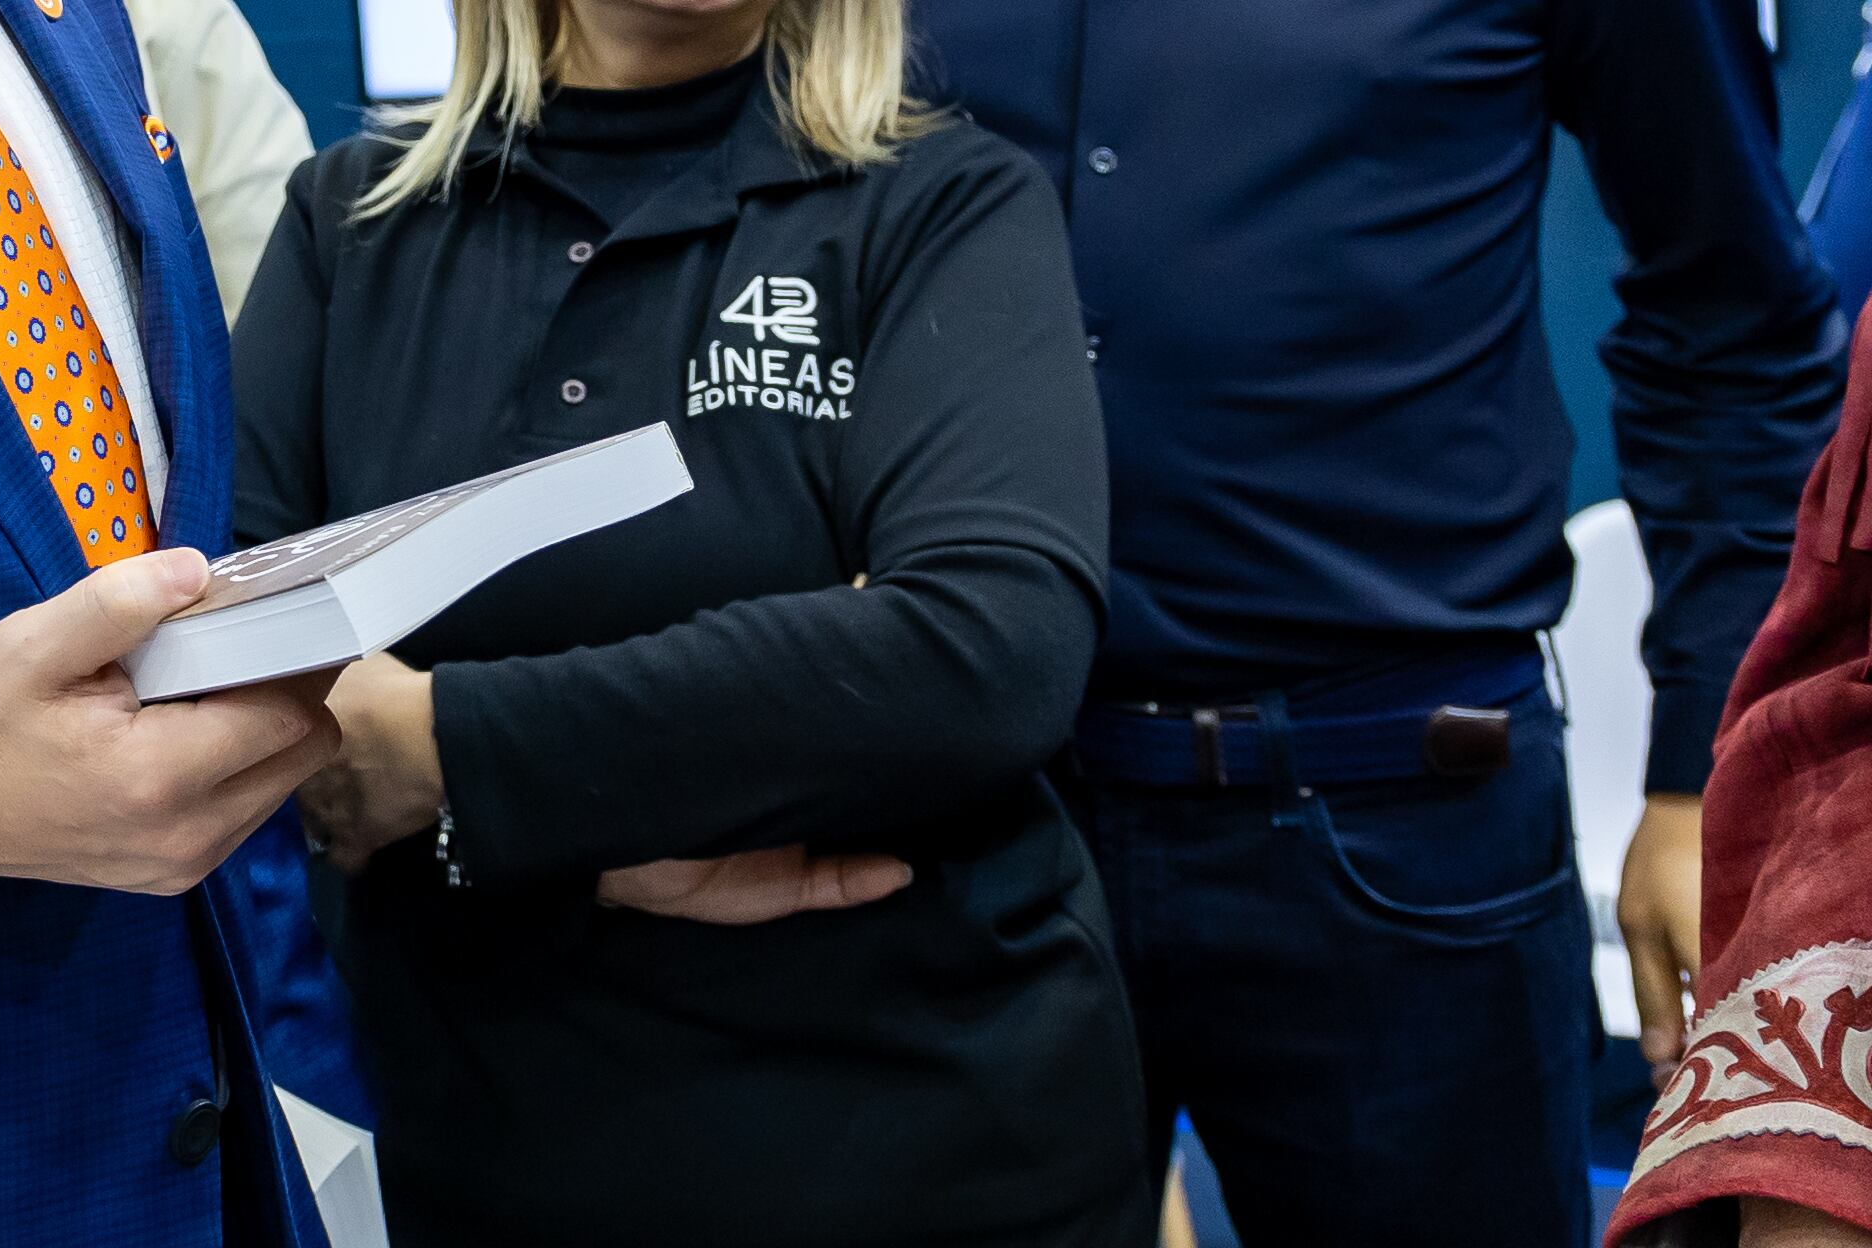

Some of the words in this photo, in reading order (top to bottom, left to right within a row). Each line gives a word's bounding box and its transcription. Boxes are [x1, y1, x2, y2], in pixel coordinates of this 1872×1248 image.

[719, 274, 821, 346] 42
[688, 339, 856, 396] LÍNEAS
[686, 384, 853, 421] EDITORIAL
